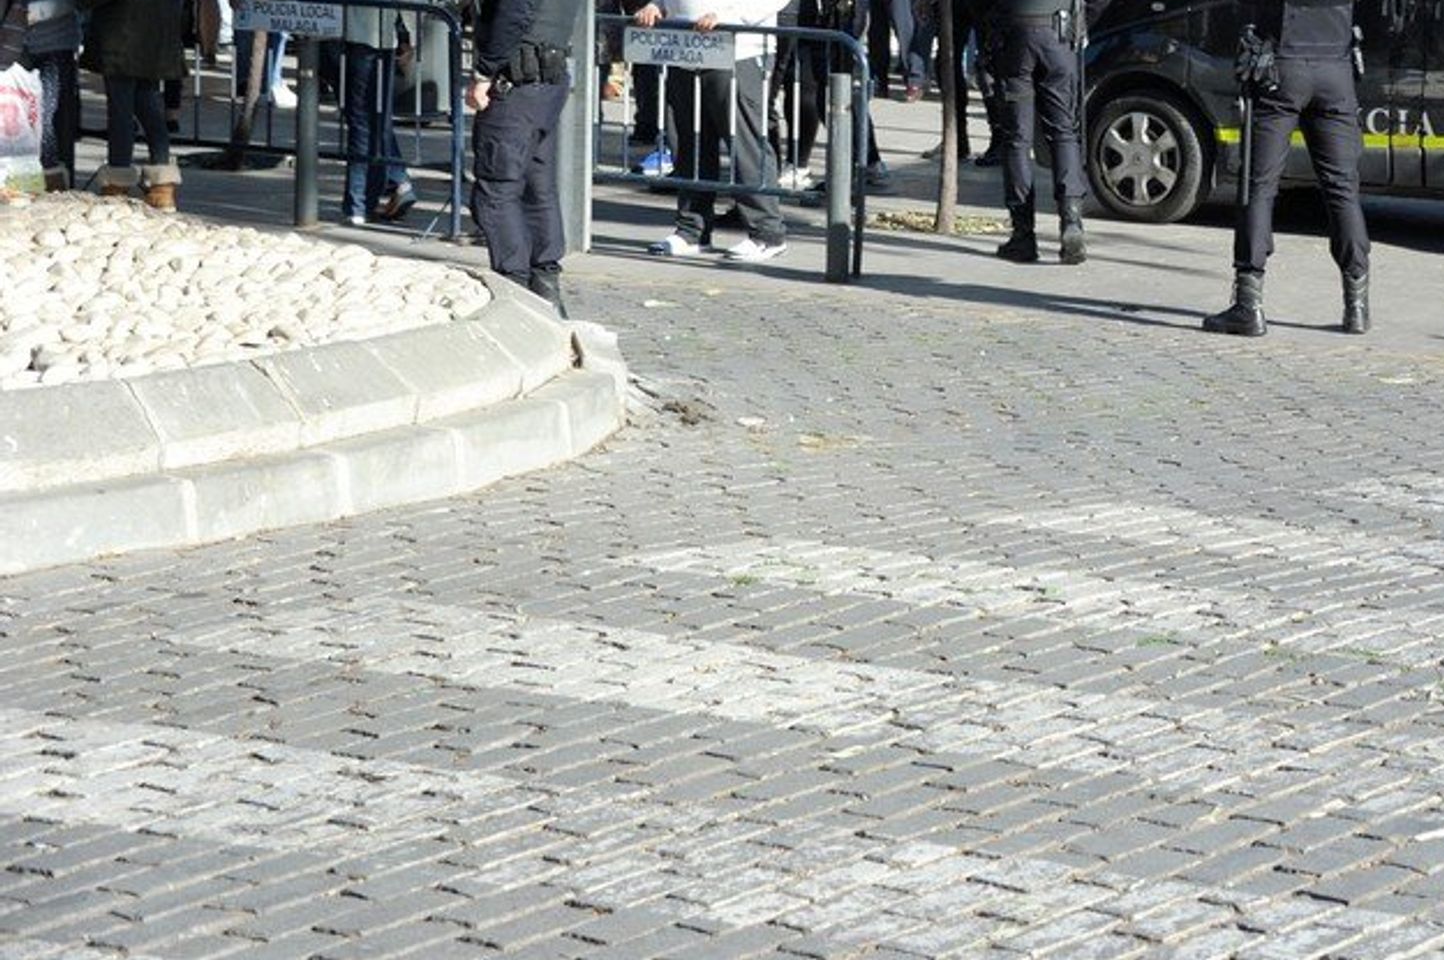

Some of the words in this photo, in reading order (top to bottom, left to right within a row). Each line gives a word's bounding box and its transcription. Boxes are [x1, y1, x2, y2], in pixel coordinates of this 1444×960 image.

[253, 0, 298, 17] POLICIA
[300, 3, 336, 20] LOCAL
[631, 30, 680, 46] POLICIA
[651, 47, 704, 64] MALAGA
